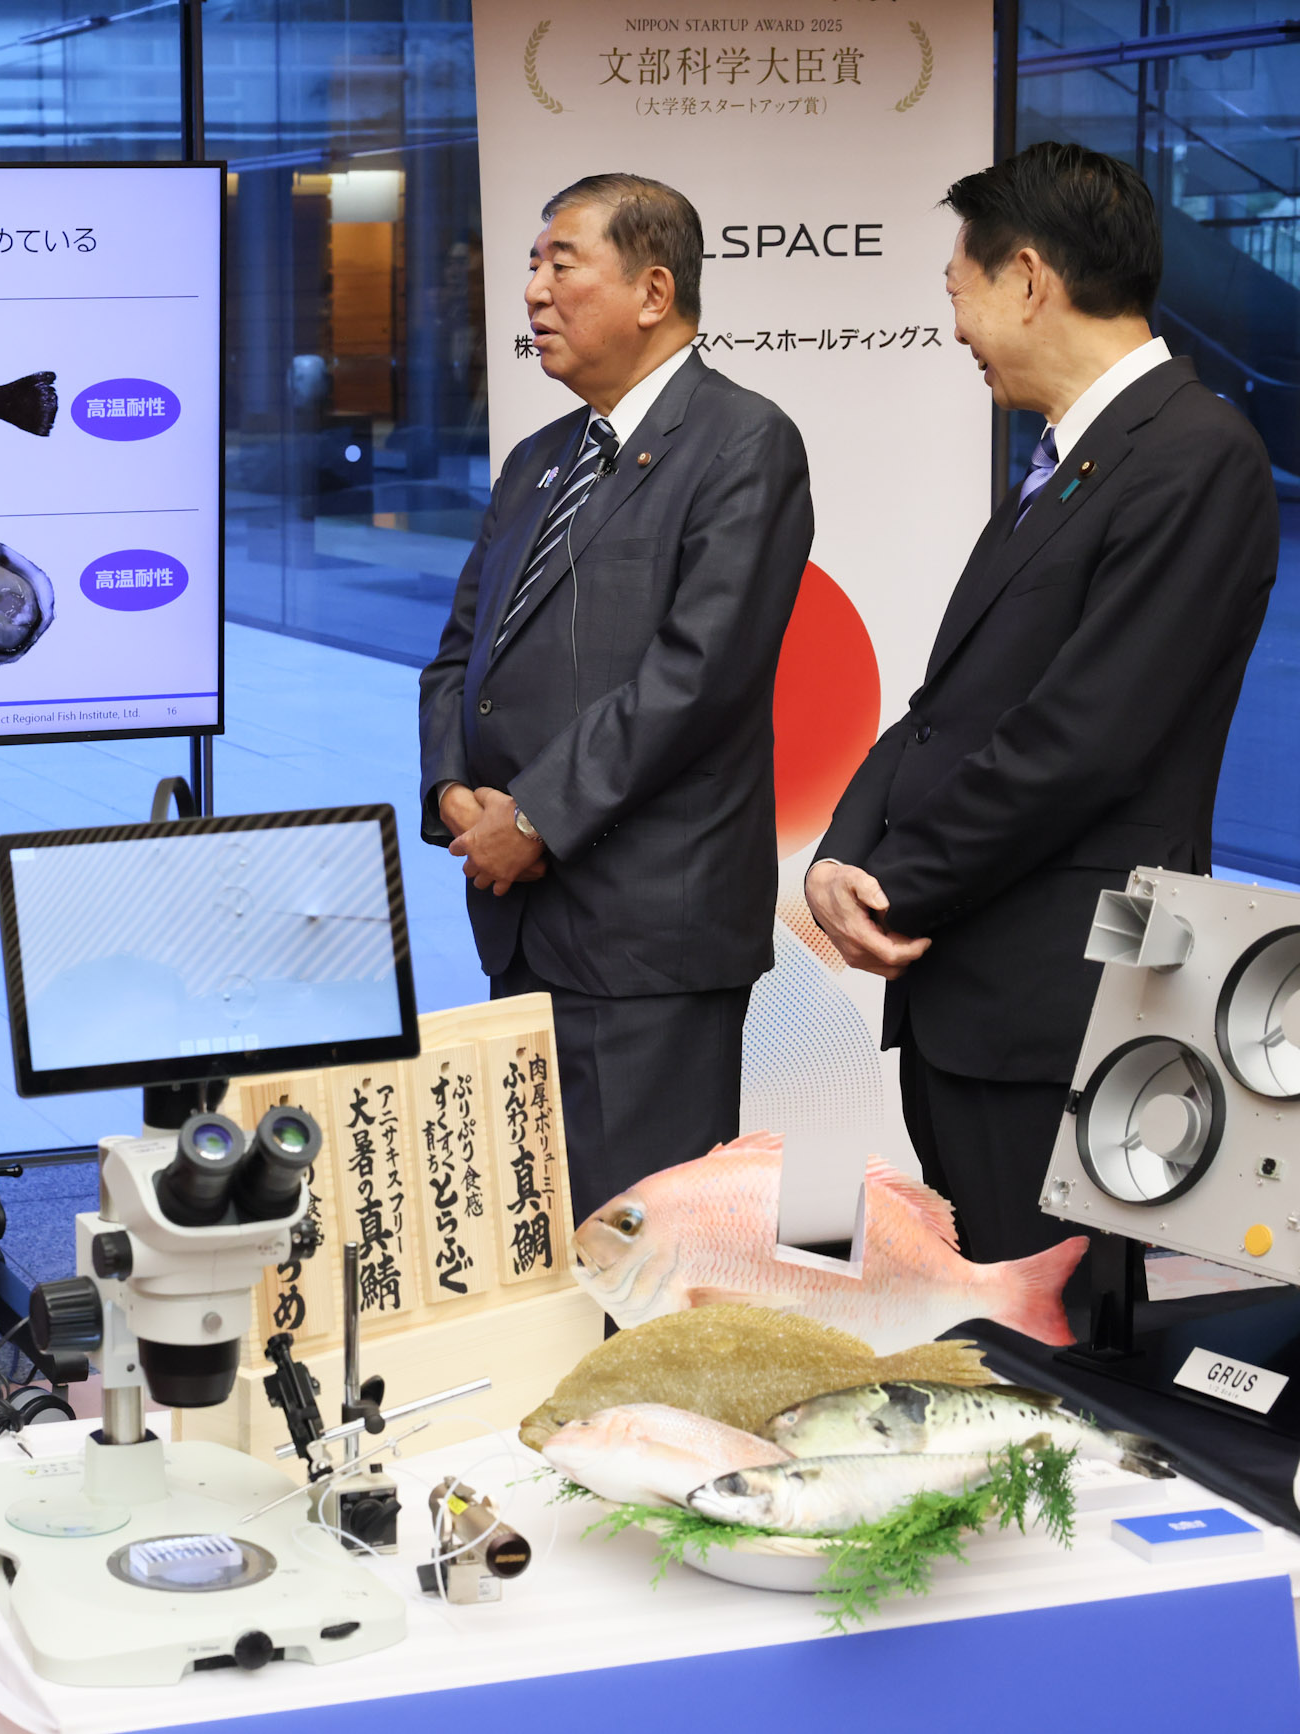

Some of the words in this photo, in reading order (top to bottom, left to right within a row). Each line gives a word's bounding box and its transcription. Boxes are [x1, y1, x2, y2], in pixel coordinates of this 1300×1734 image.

[625, 18, 679, 32] NIPPON
[685, 18, 749, 32] STARTUP
[754, 18, 805, 32] AWARD
[811, 18, 843, 32] 2025
[598, 46, 865, 86] 文部科学大臣賞
[635, 96, 828, 116] （大学発スタートアップ賞）
[701, 223, 883, 259] SPACE
[86, 397, 166, 419] 高温耐性
[95, 568, 174, 590] 高温耐性
[12, 711, 55, 725] Regional
[58, 710, 76, 722] Fish
[79, 708, 120, 721] Institute,
[123, 707, 141, 719] Ltd.
[166, 706, 177, 716] 16
[528, 1053, 556, 1210] 肉厚ボリューミー
[376, 1085, 405, 1254] アニサキスフリー
[1207, 1362, 1258, 1392] GRUS
